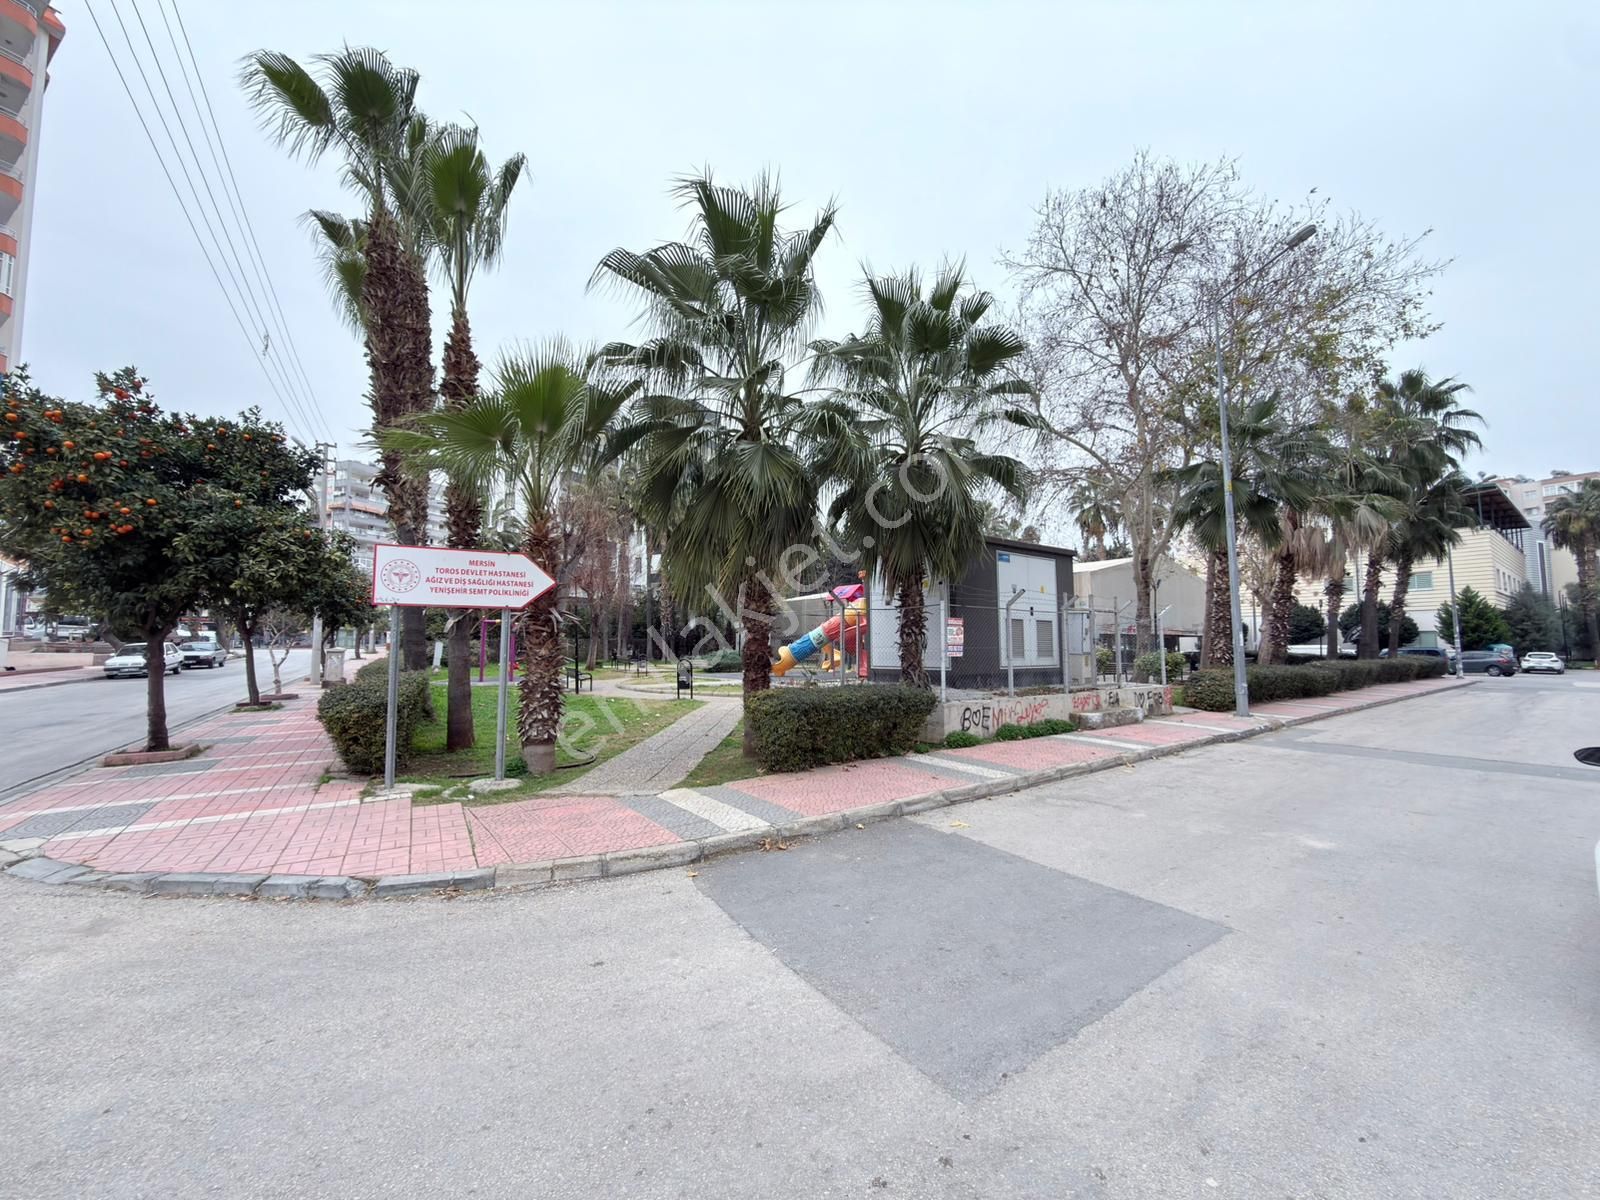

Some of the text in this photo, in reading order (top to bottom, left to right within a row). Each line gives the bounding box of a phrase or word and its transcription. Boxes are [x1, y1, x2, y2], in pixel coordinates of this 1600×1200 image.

[468, 559, 496, 567] MERSİN
[435, 567, 526, 578] TOROS DEVLET HASTANESİ
[425, 576, 534, 588] AĞIZ VE DİŞ SAĞLIĞI HASTANESİ
[430, 586, 468, 595] YENİŞEHİR
[488, 588, 530, 597] POLİKLİNİĞİ
